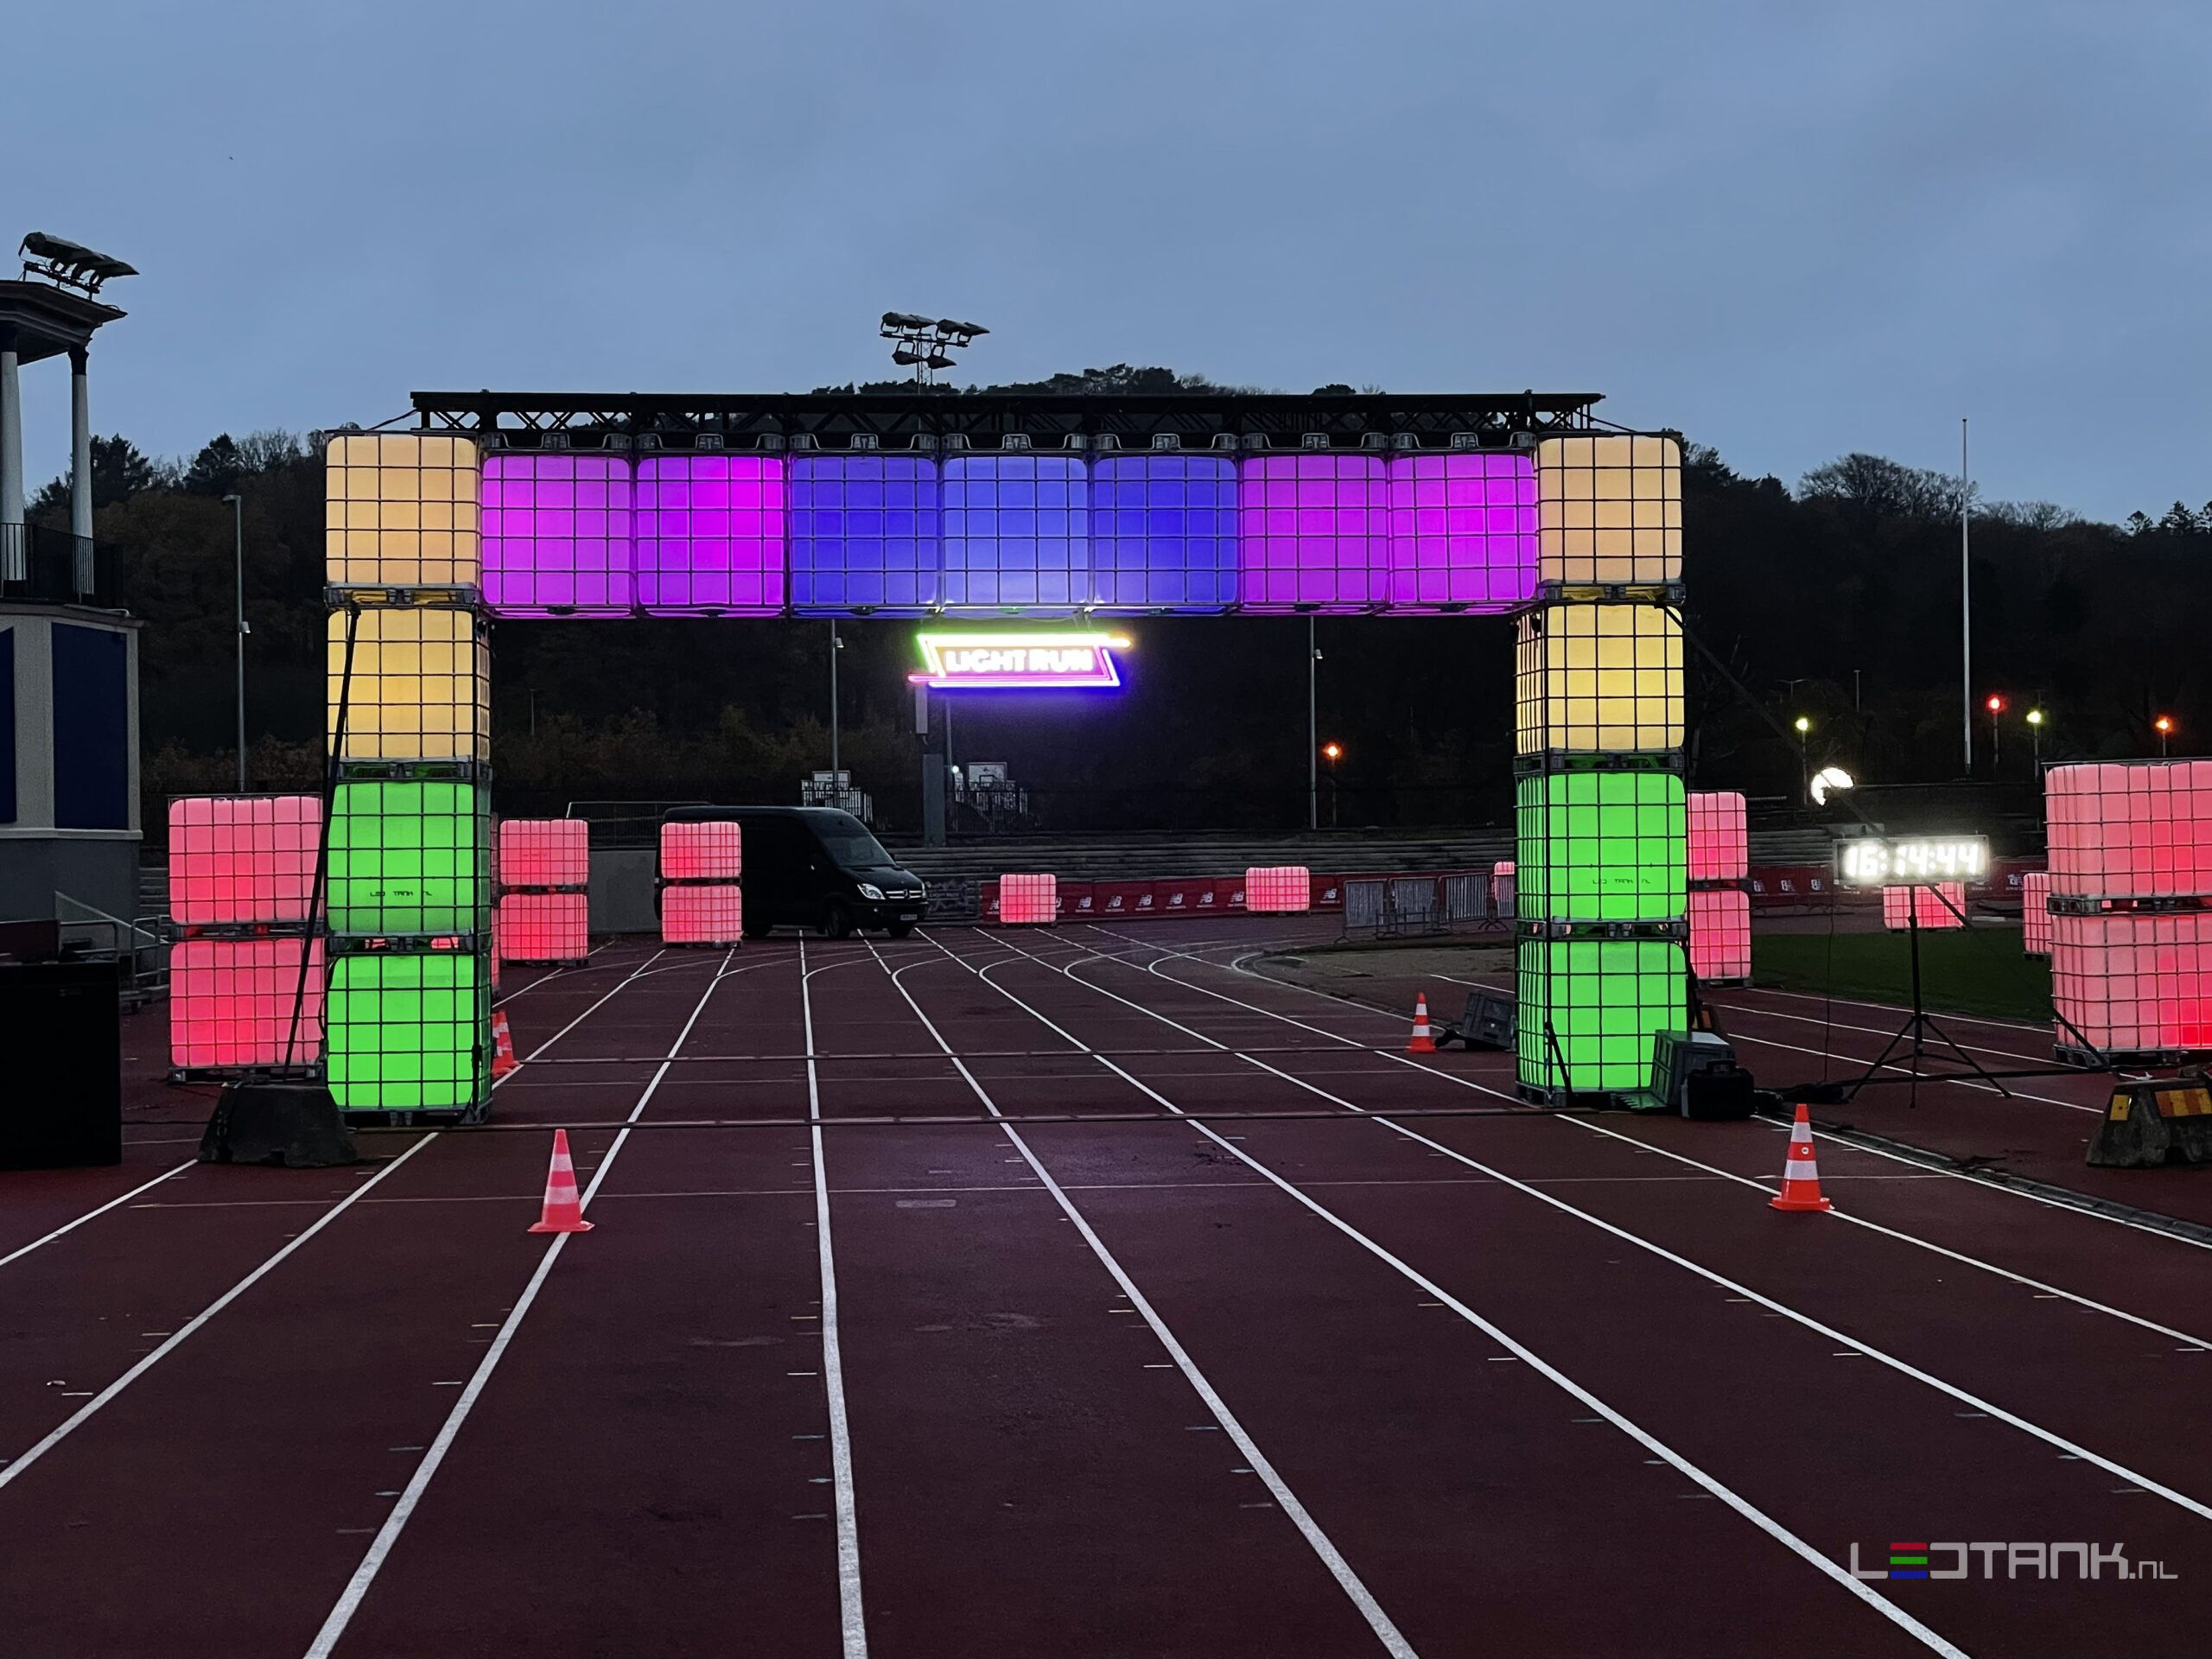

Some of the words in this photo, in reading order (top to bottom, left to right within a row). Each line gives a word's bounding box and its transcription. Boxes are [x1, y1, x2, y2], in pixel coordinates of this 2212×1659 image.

[945, 649, 1027, 672] LIGHT
[1029, 649, 1094, 671] RUN
[1845, 842, 1979, 877] 16:14:44
